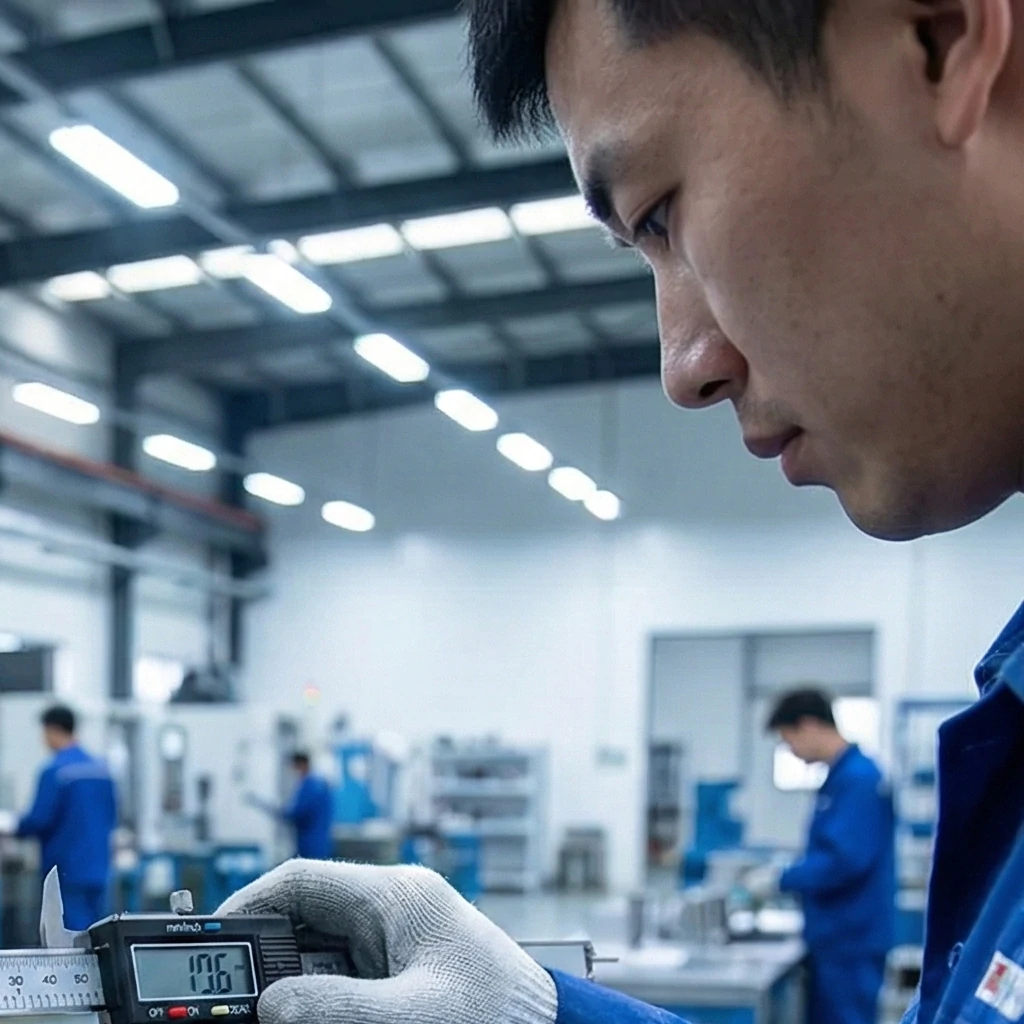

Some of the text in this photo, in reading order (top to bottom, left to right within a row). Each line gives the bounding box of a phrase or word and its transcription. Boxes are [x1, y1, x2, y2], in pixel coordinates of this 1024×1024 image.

[8, 975, 24, 987] 30
[42, 974, 57, 985] 40
[74, 973, 89, 984] 50
